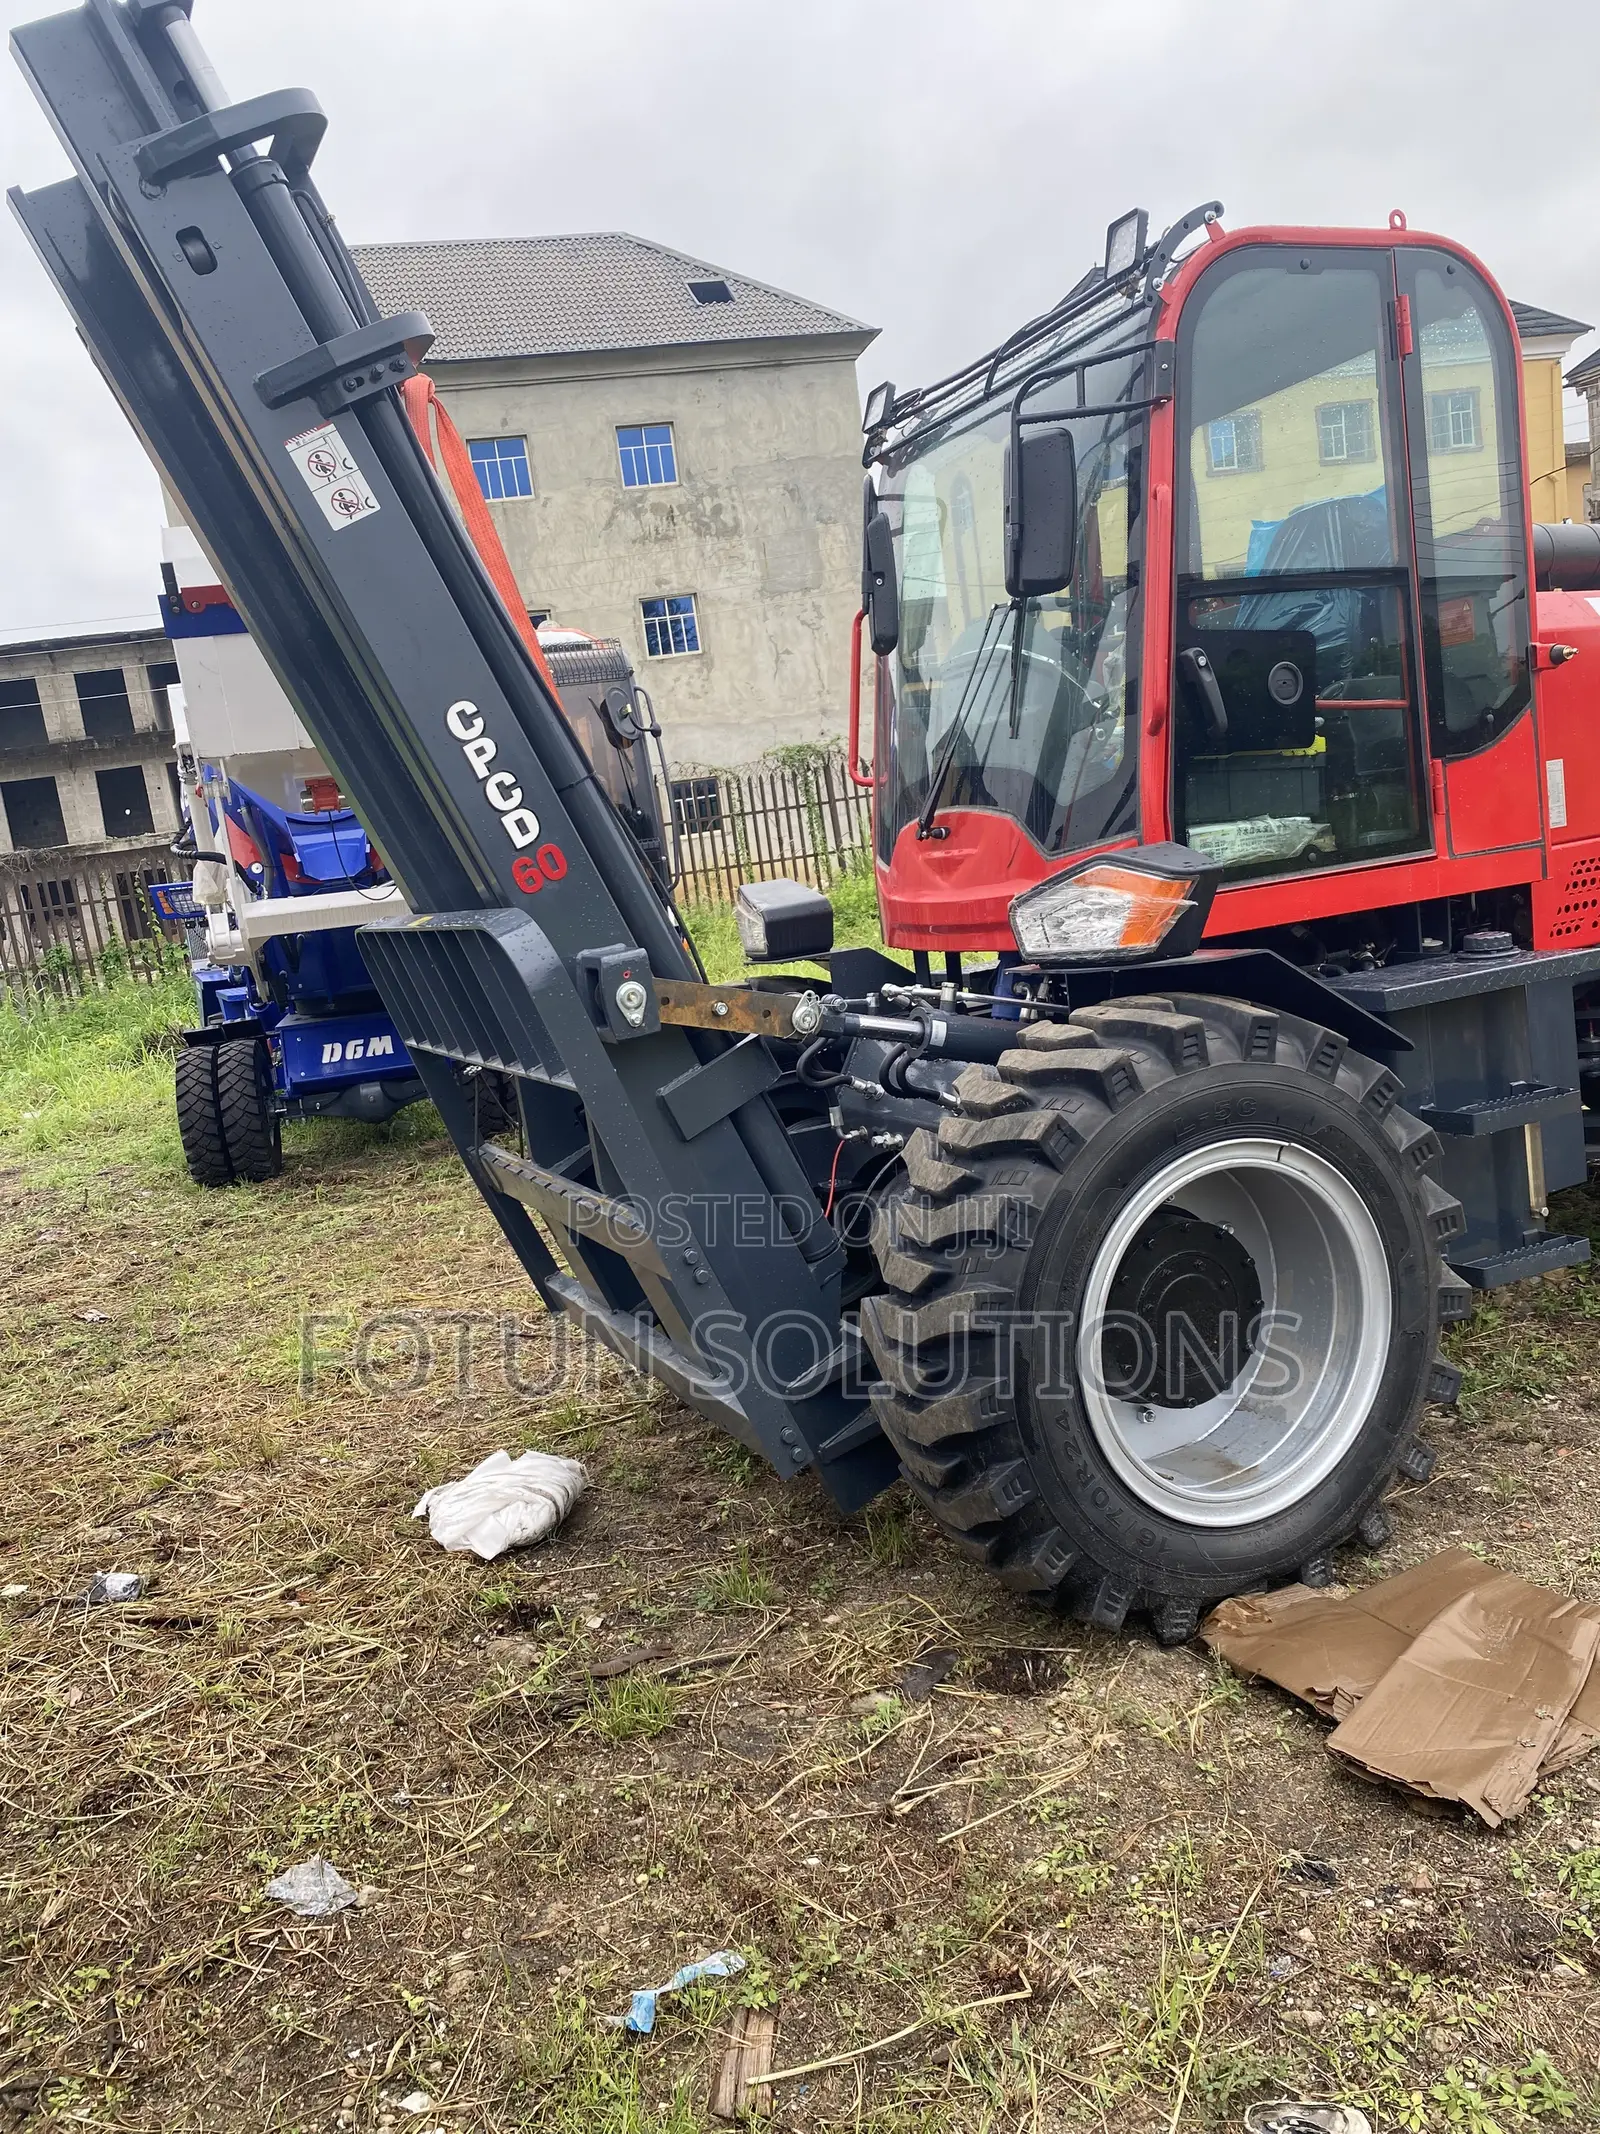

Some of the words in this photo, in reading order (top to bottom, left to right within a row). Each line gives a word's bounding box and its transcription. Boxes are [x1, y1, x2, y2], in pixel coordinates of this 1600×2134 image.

[445, 699, 541, 850] CPCD
[512, 843, 568, 894] 60
[321, 1035, 394, 1064] DGM
